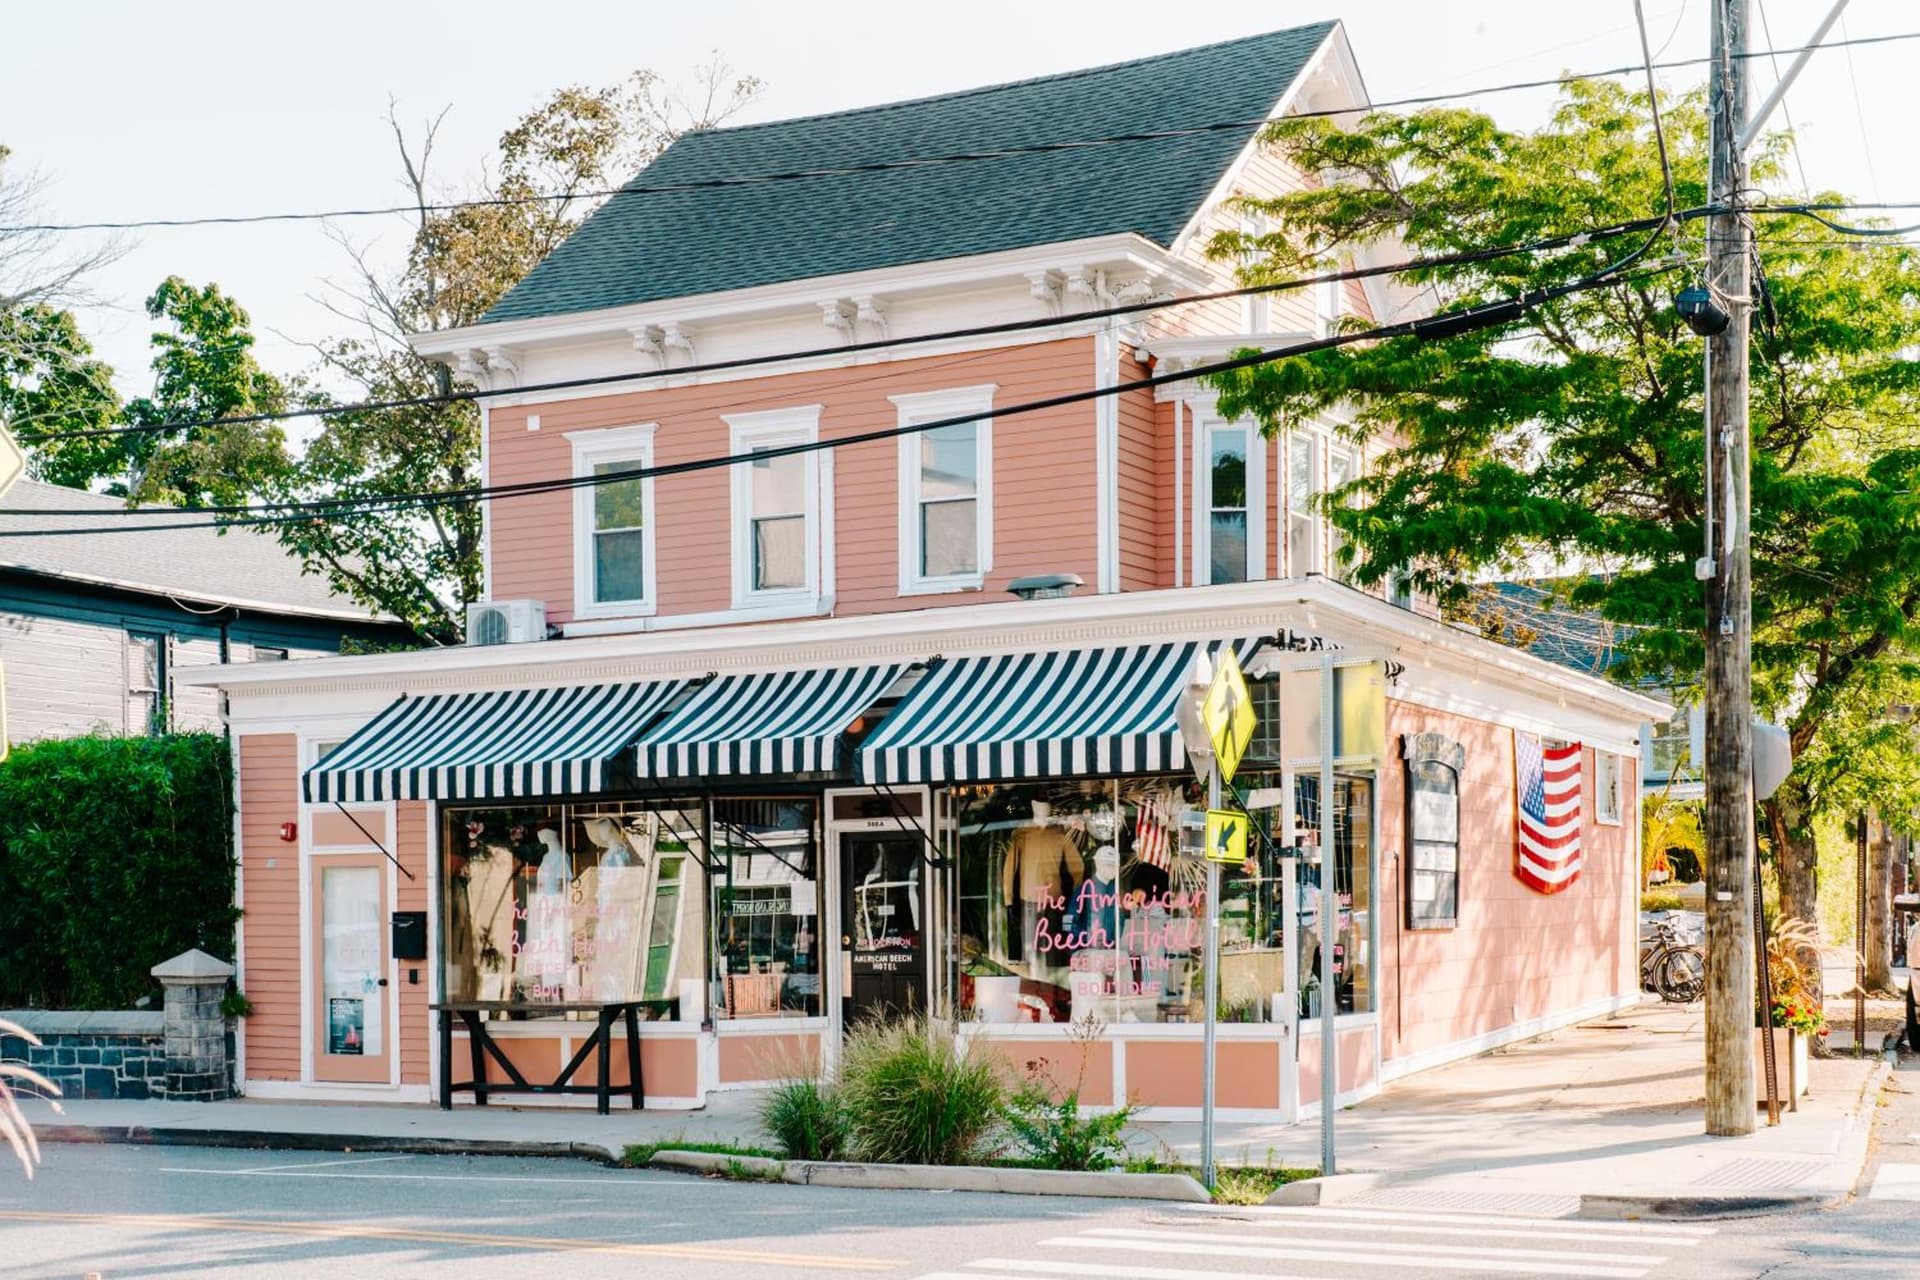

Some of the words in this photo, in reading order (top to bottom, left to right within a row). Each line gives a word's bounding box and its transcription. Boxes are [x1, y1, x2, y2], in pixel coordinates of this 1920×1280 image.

[1033, 884, 1066, 912] The
[1076, 879, 1208, 914] American
[1034, 917, 1115, 952] Beech
[1125, 915, 1204, 951] Hotel
[854, 955, 888, 963] AMERICAN
[889, 954, 912, 962] BEECH
[1069, 956, 1170, 972] RECEPTION
[873, 963, 897, 971] HOTEL
